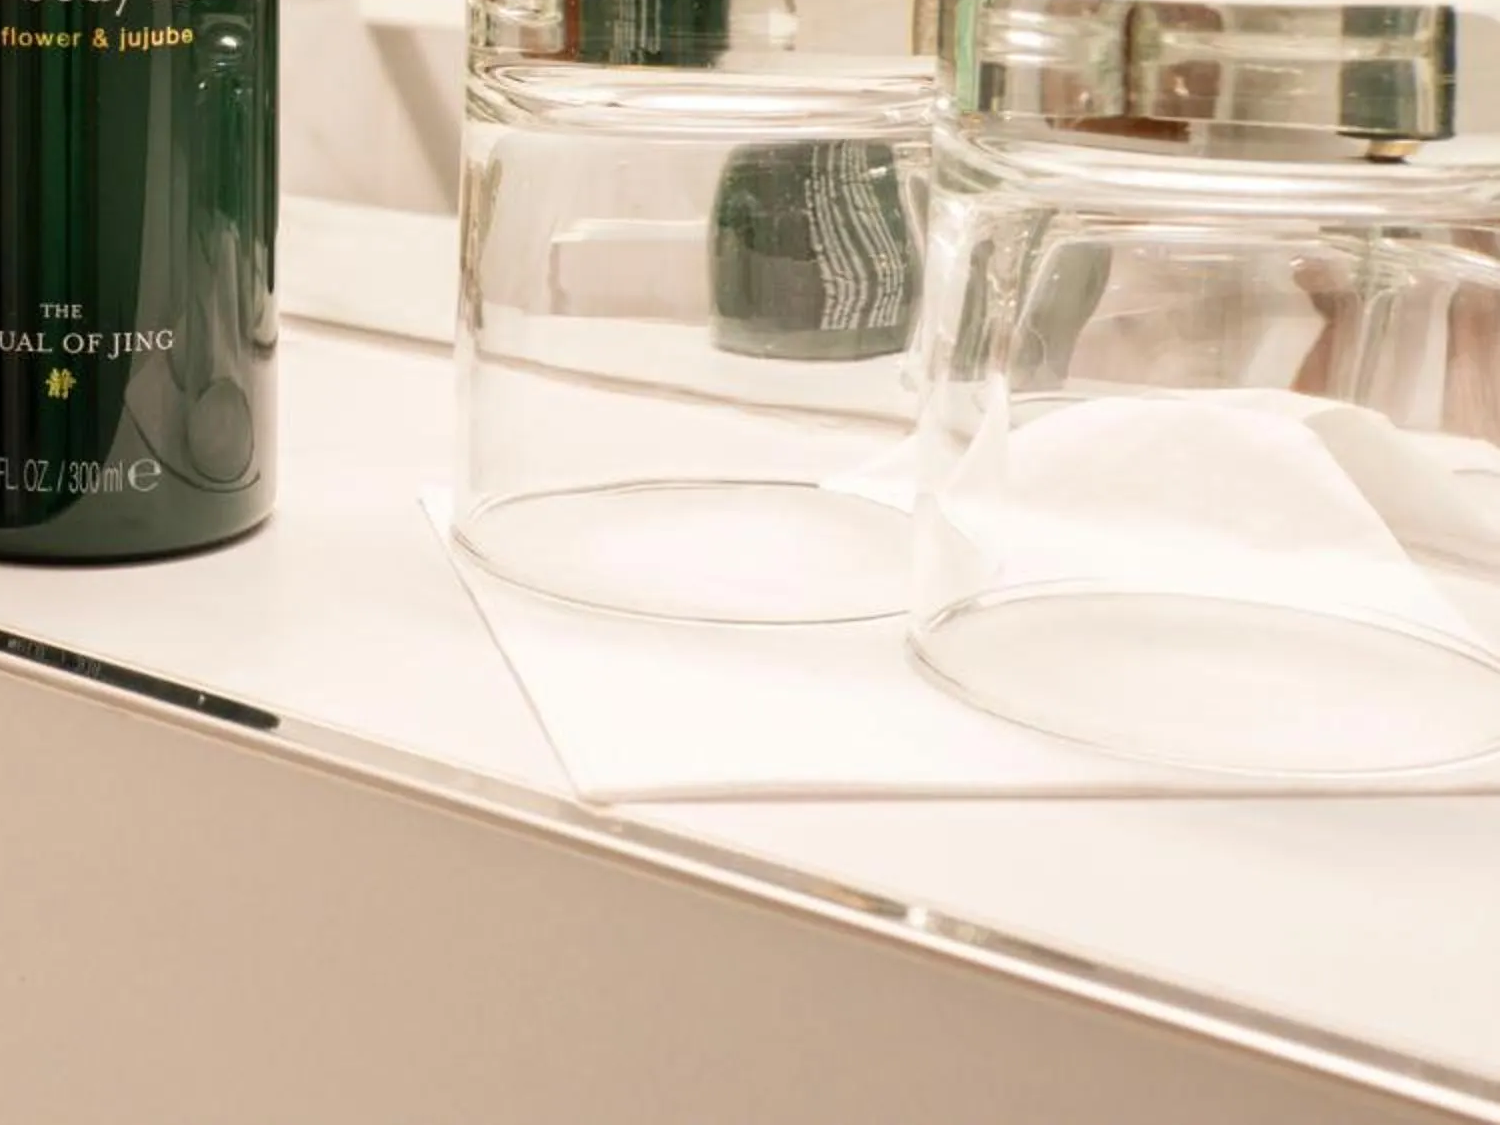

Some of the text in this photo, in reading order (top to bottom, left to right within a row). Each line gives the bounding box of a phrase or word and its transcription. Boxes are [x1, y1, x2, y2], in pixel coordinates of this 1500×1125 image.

[0, 26, 83, 48] flower
[91, 27, 110, 48] &
[118, 25, 195, 52] jujube
[39, 303, 83, 320] THE
[62, 332, 103, 354] OF
[107, 328, 175, 360] JING
[68, 460, 100, 495] 300
[102, 460, 124, 492] ml
